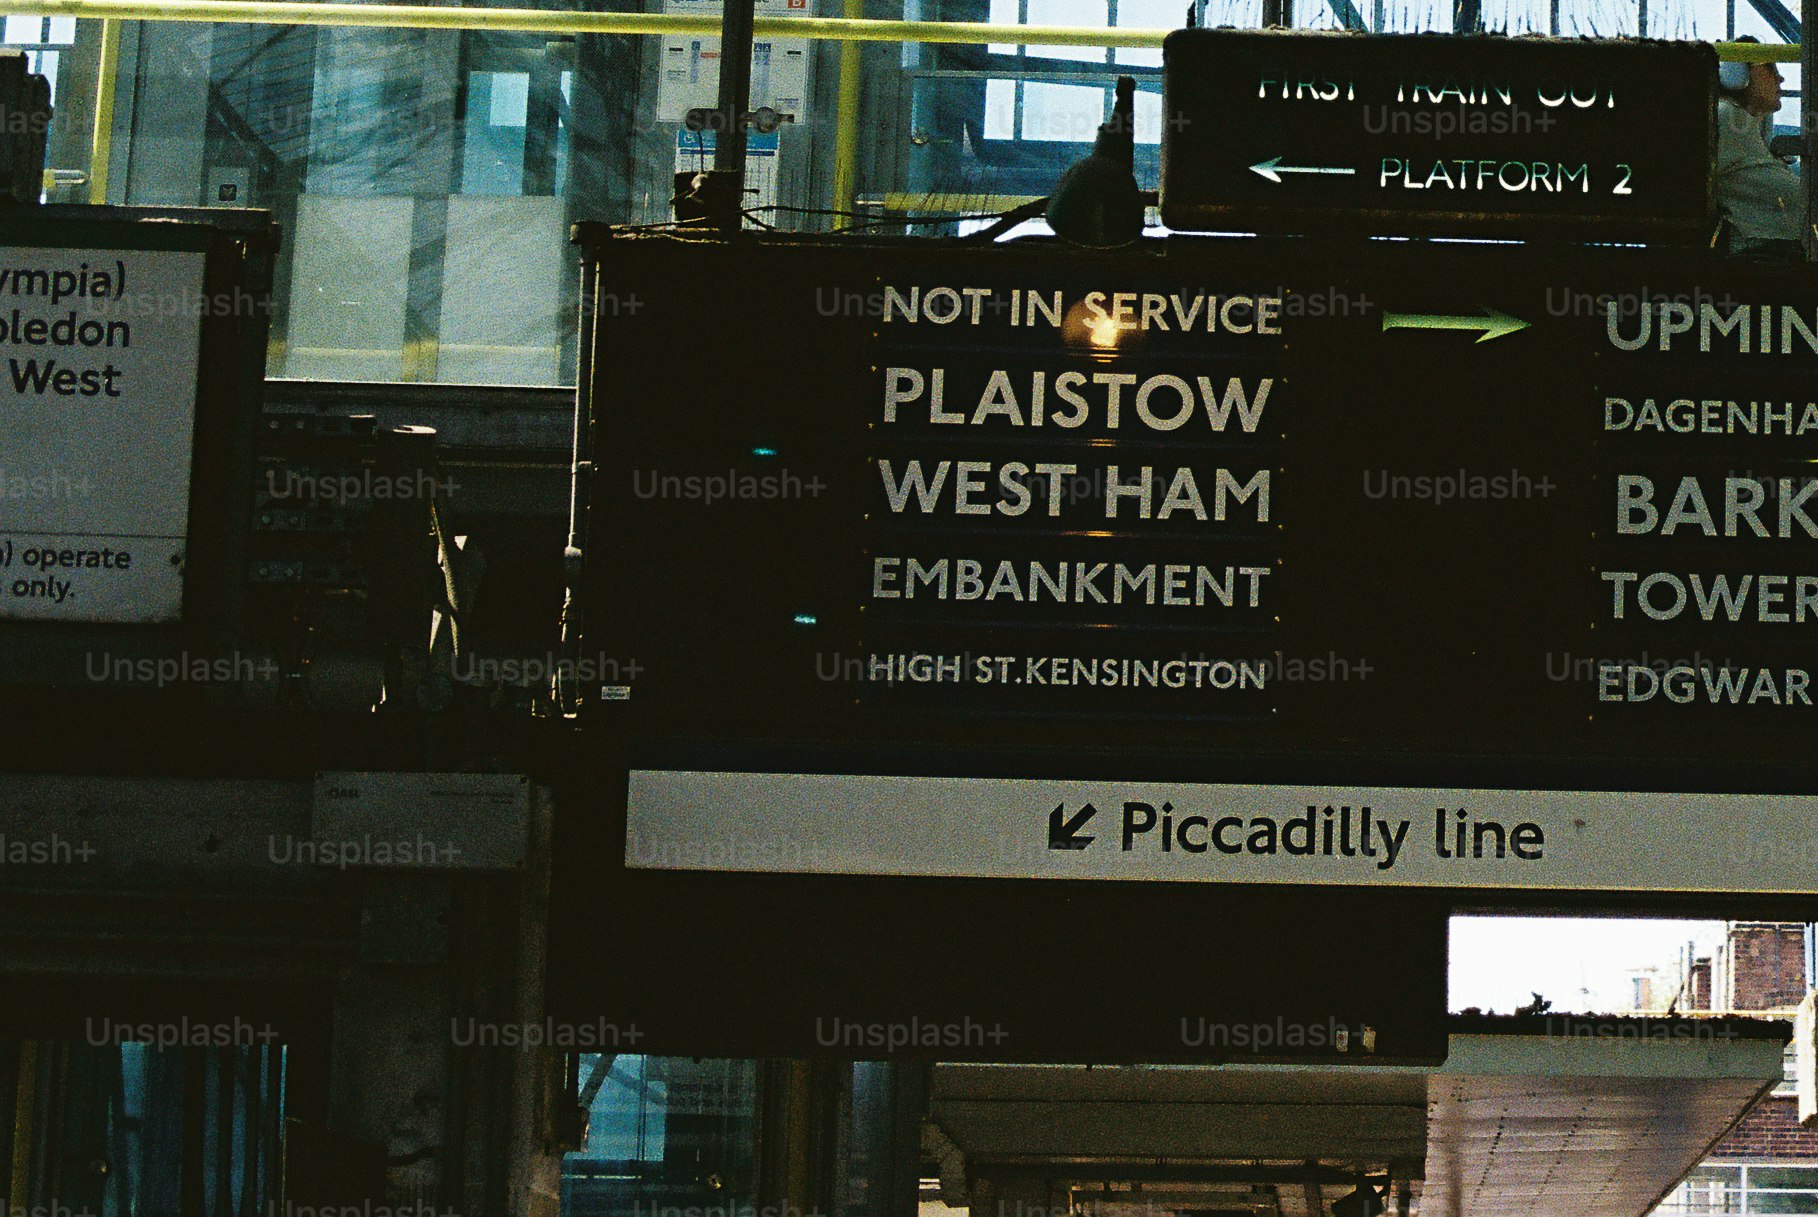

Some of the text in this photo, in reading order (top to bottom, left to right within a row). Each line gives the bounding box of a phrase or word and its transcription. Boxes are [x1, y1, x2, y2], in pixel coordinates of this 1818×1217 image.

[1257, 69, 1355, 102] FIRST
[1396, 71, 1511, 106] TRAIN
[1379, 157, 1633, 195] PLATFORM 2
[883, 286, 1283, 336] NOT IN SERVICE
[10, 358, 122, 398] West
[884, 367, 1275, 433] PLAISTOW
[877, 459, 1272, 523] WEST HAM
[22, 548, 132, 574] operate
[12, 576, 76, 603] only.
[871, 557, 1272, 609] EMBANKMENT
[868, 653, 961, 684] HIGH
[1122, 799, 1546, 870] Piccadilly line
